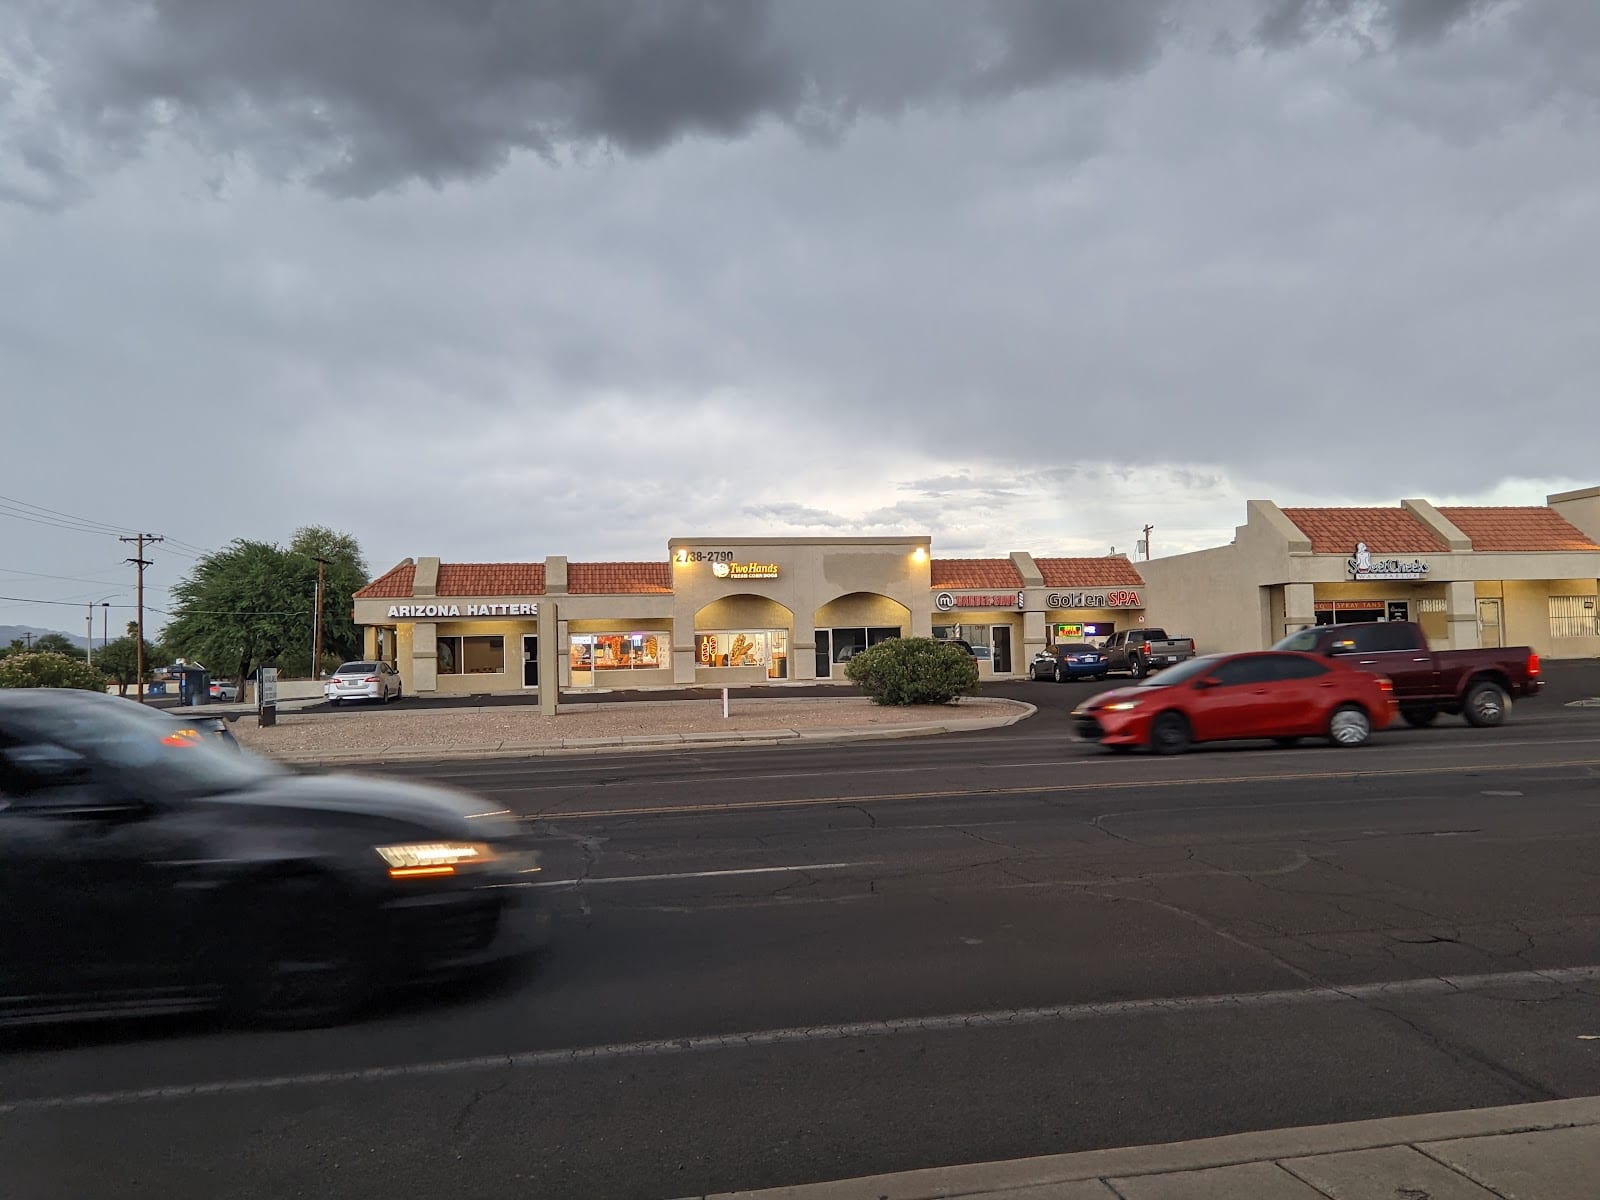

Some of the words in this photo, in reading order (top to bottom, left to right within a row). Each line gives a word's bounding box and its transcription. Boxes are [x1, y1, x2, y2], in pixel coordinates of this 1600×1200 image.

[730, 562, 748, 574] Two
[748, 562, 778, 574] Hands
[1348, 559, 1389, 573] Seet
[1046, 591, 1105, 608] Golden
[1107, 590, 1140, 607] SPA
[388, 605, 460, 617] ARIZONA
[467, 603, 538, 616] HATTERS
